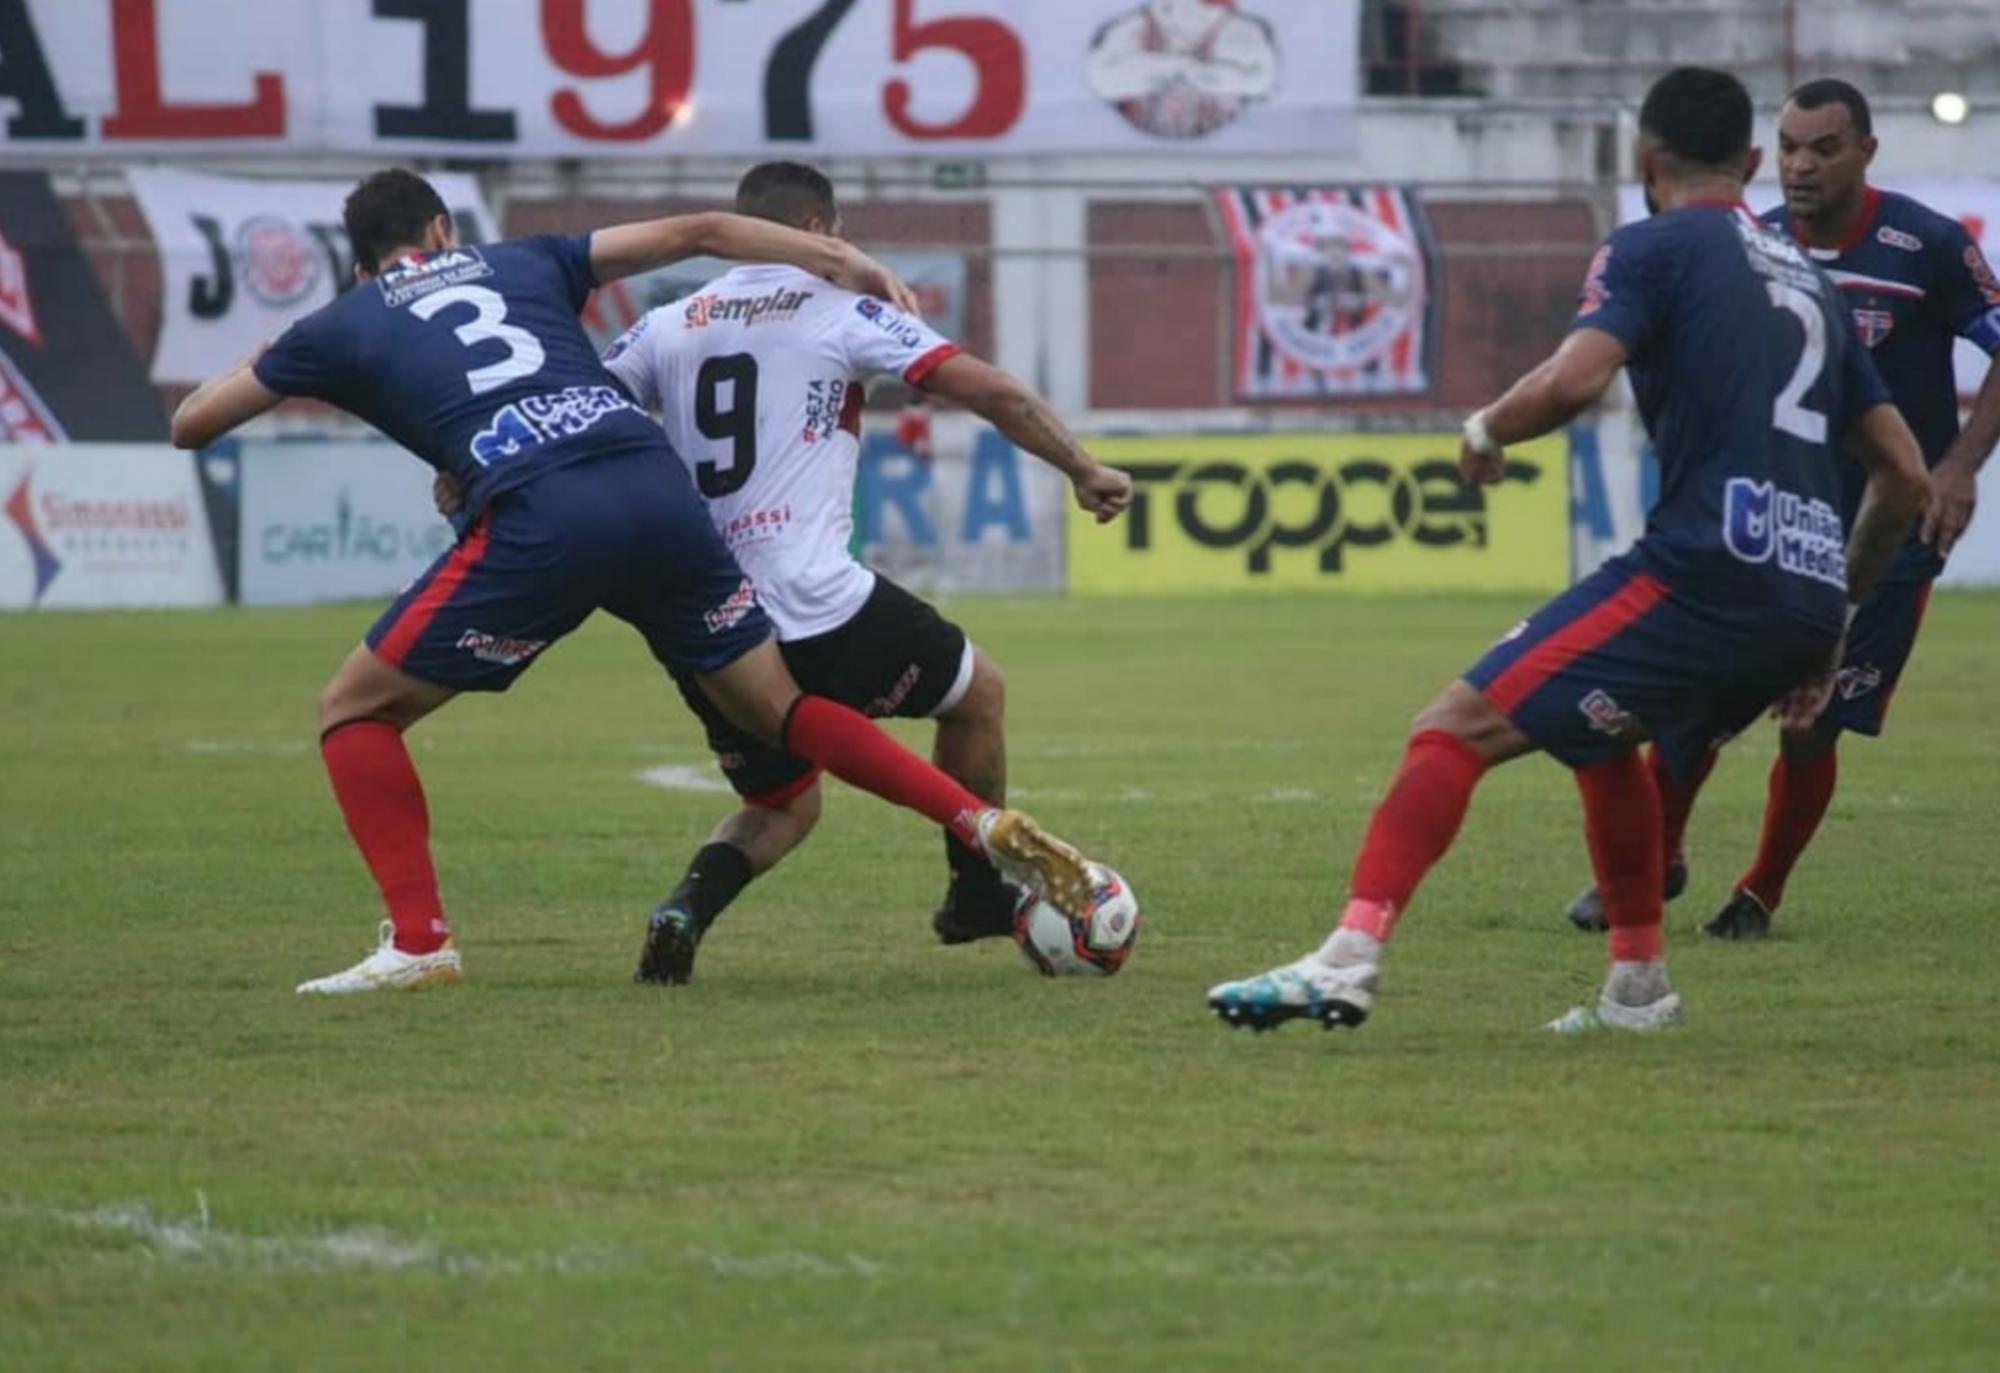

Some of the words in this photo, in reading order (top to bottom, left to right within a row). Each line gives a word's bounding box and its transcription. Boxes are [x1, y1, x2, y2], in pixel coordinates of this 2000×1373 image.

[408, 284, 547, 395] 3
[1766, 279, 1829, 444] 2
[694, 352, 760, 499] 9
[1780, 533, 1849, 588] Médic
